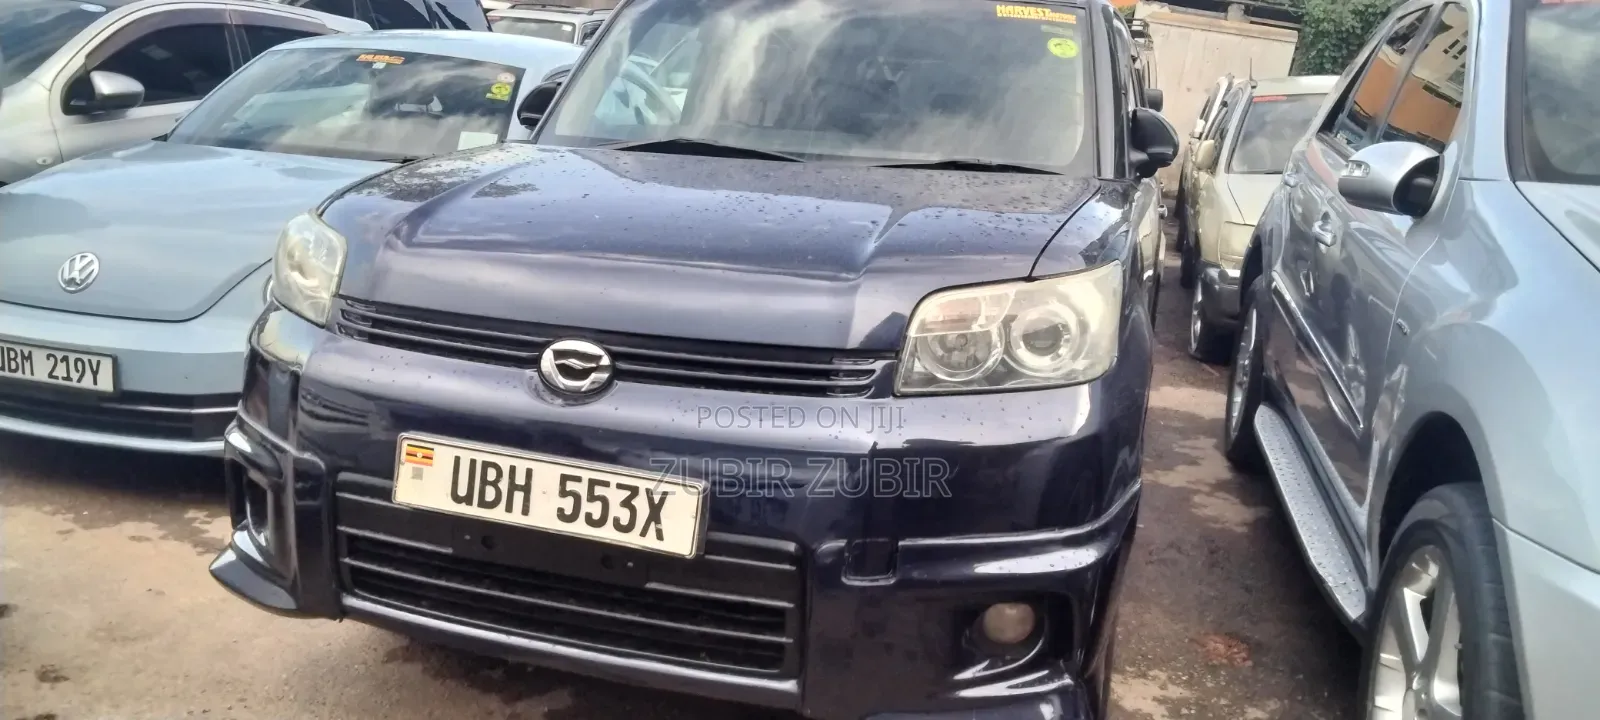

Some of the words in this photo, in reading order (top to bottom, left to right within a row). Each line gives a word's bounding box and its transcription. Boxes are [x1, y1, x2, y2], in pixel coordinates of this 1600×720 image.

[997, 5, 1051, 17] HARVEST
[59, 252, 99, 291] VW
[46, 353, 101, 386] 219Y
[450, 455, 533, 516] UBH
[556, 473, 668, 541] 553X
